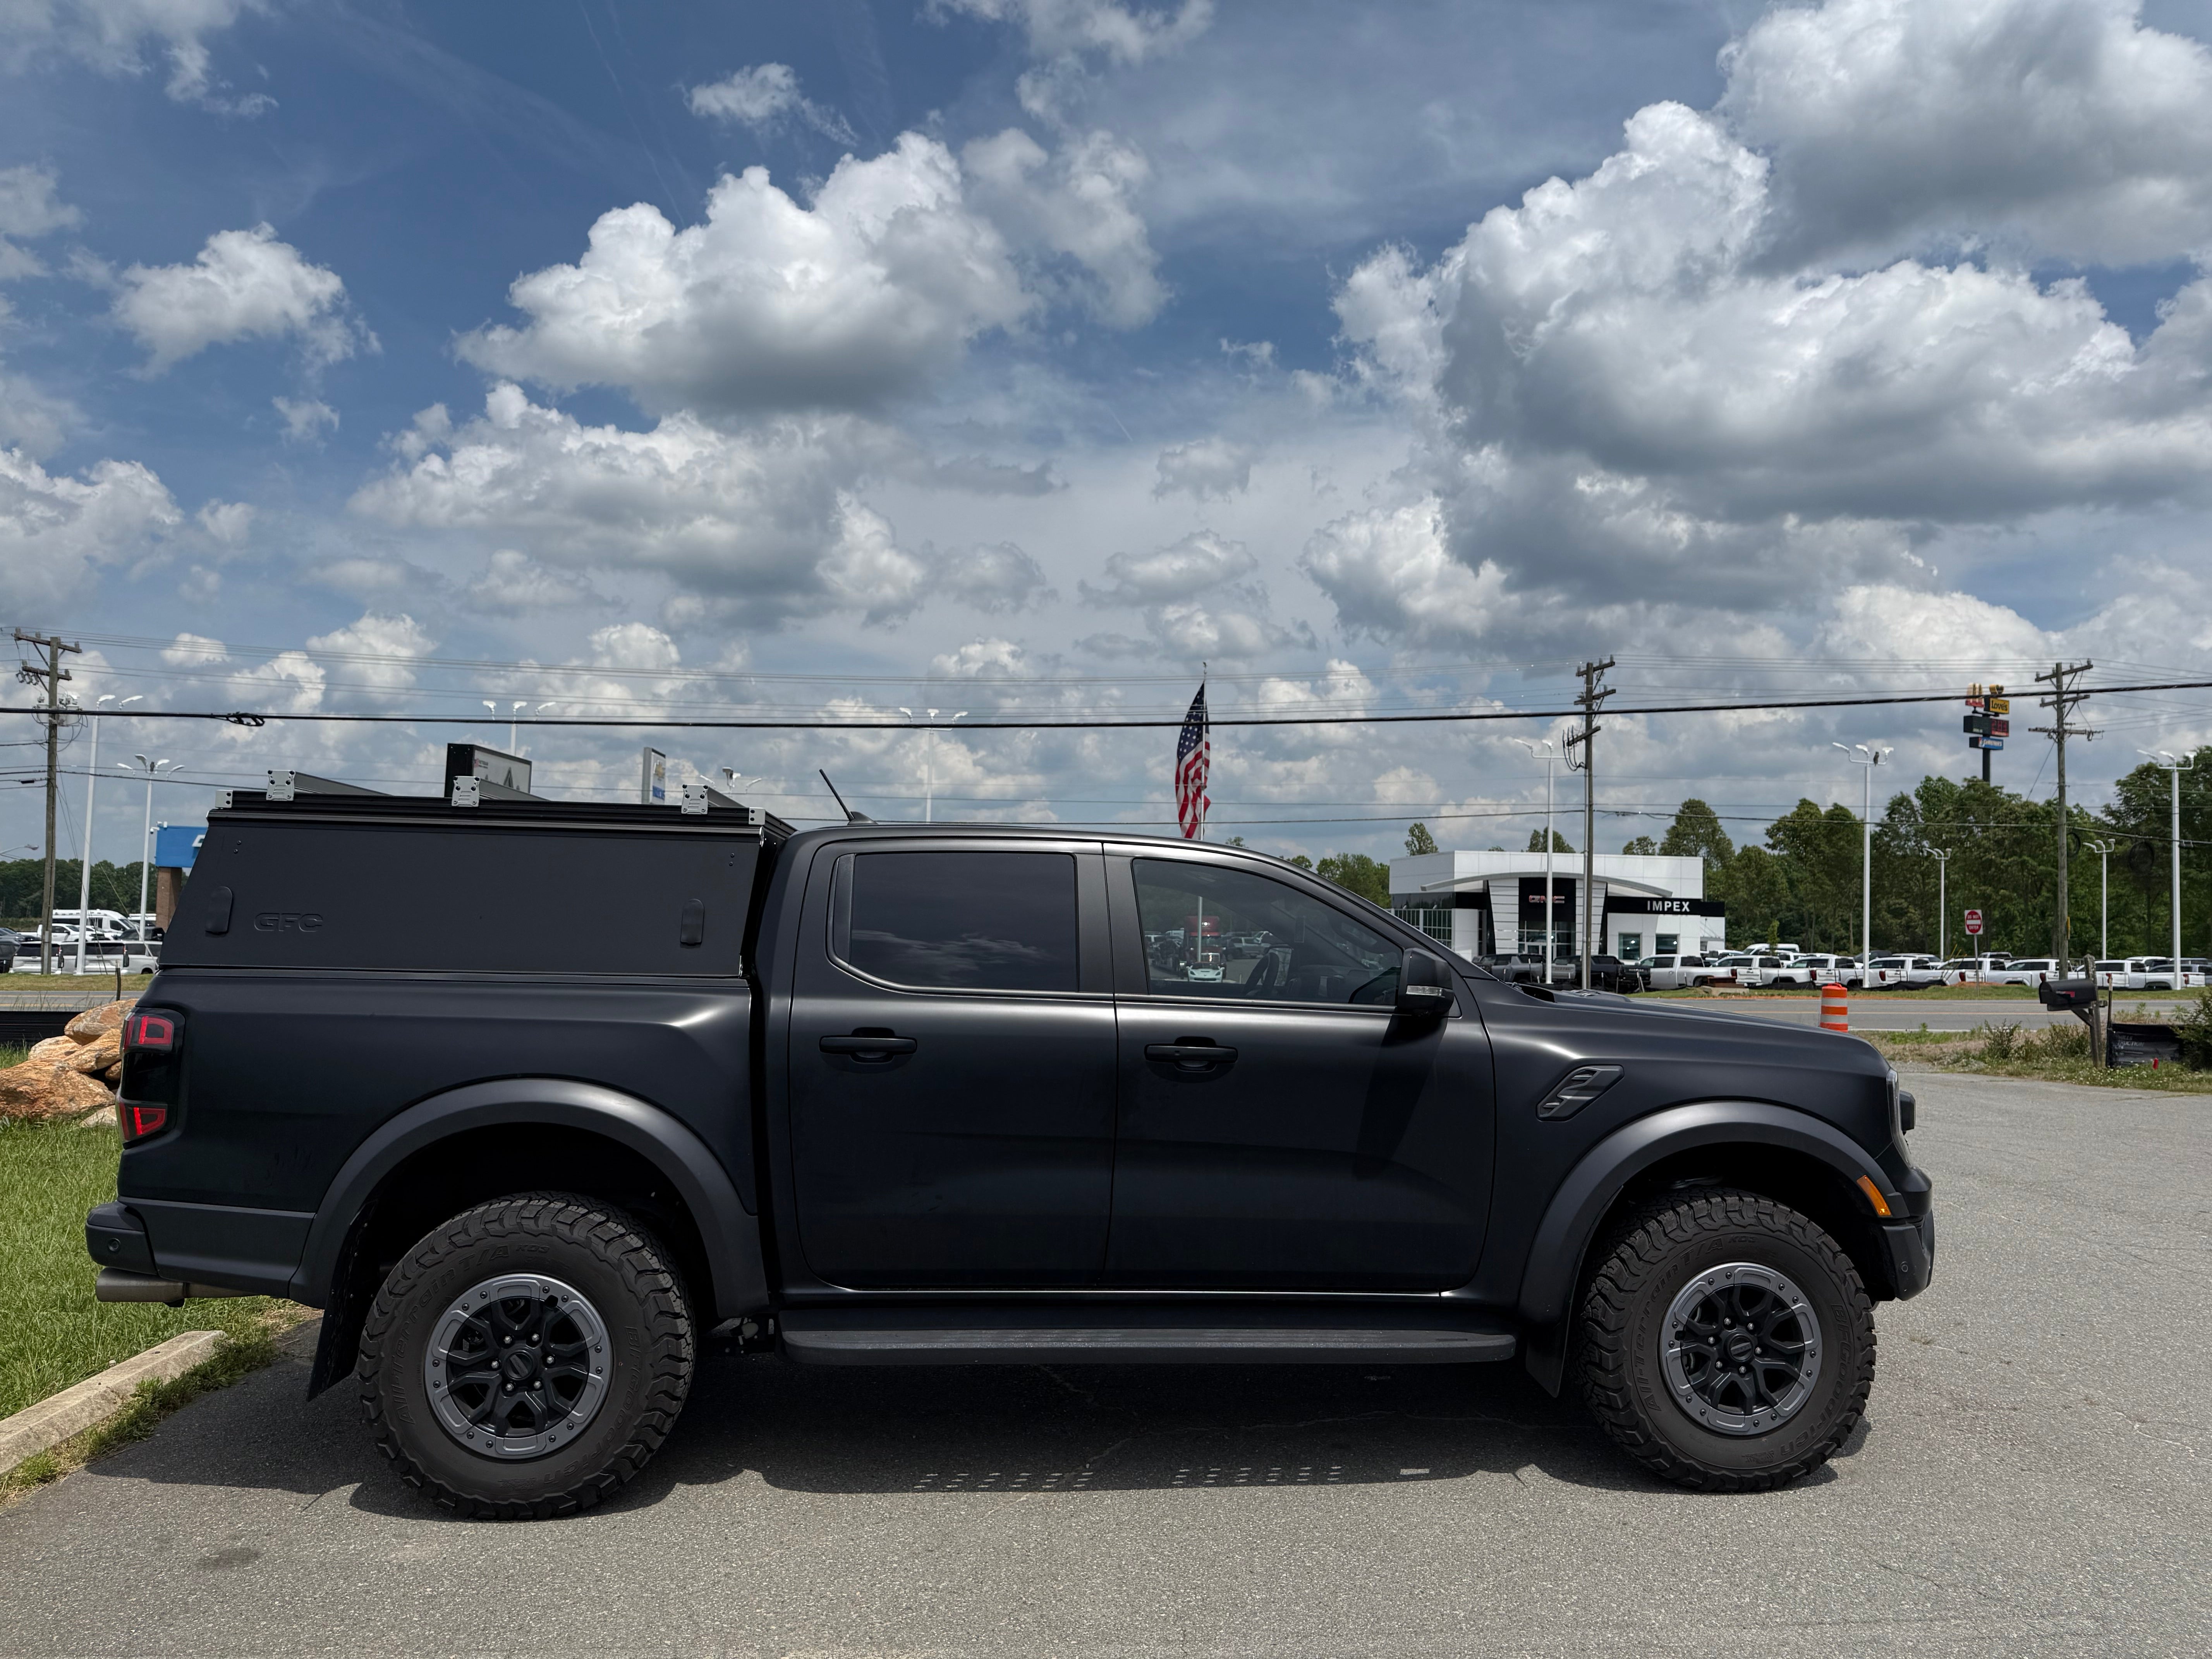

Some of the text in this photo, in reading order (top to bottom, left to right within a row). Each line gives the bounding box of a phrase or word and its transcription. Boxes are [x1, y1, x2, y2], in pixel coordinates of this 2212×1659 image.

[1991, 700, 2008, 711] Love's
[1647, 900, 1690, 912] IMPEX
[254, 913, 323, 932] GFC
[458, 1245, 510, 1271] T/A
[1680, 1237, 1723, 1265] T/A
